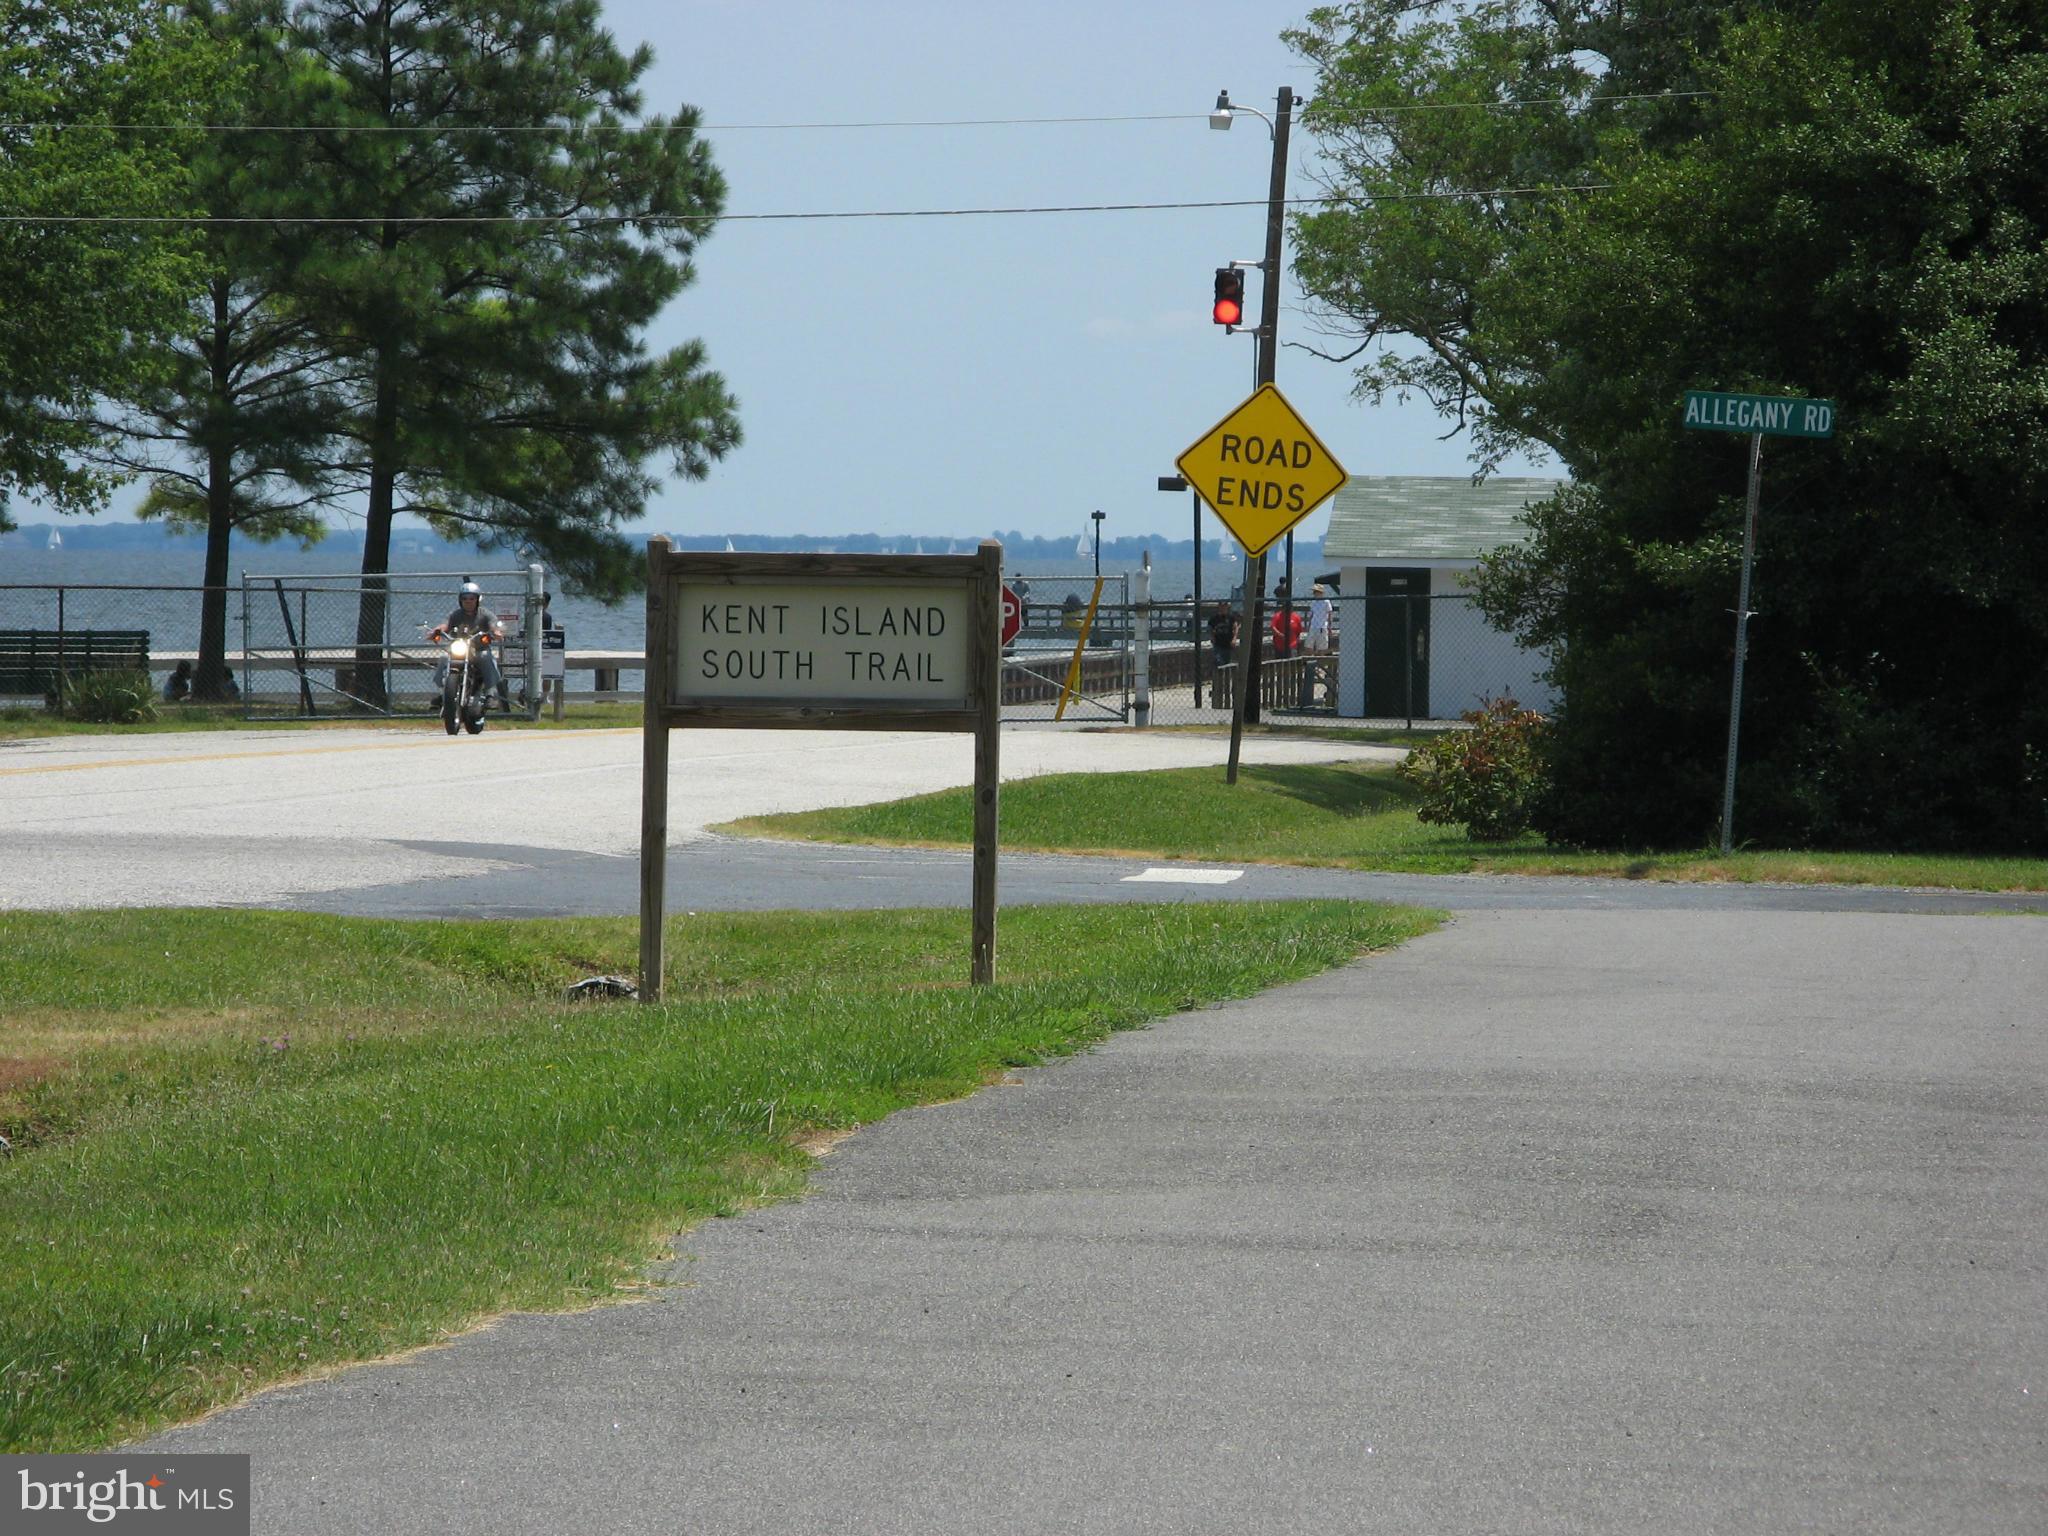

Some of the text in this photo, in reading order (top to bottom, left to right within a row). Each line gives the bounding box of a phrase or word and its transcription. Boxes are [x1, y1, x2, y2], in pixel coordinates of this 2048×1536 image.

[1686, 396, 1831, 432] ALLEGANY RD
[1220, 433, 1312, 469] ROAD
[1216, 476, 1305, 512] ENDS
[702, 604, 945, 637] KENT ISLAND
[702, 649, 944, 682] SOUTH TRAIL
